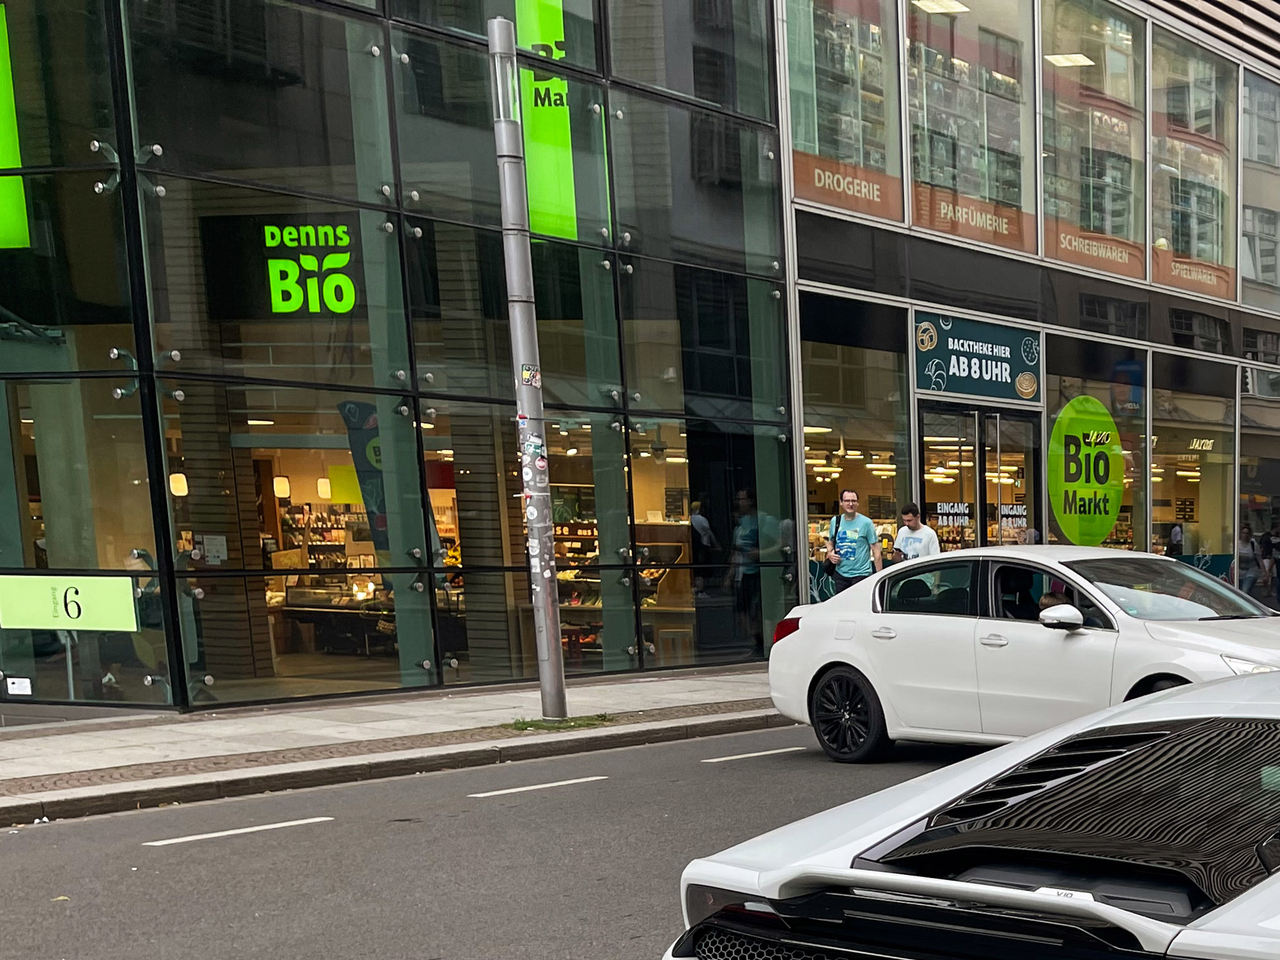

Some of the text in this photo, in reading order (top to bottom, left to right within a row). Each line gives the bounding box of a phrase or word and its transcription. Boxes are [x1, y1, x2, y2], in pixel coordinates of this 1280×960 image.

[534, 87, 568, 107] Ma
[814, 168, 881, 201] DROGERIE
[941, 202, 1008, 234] PARFÜMERIE
[264, 225, 350, 247] Denns
[1060, 233, 1129, 263] SCHREIBWAREN
[268, 254, 355, 313] Bio
[1171, 262, 1217, 285] SPIELWAREN
[948, 337, 1011, 358] BACKTHEKE HIER
[949, 355, 1011, 383] AB 8 UHR
[1064, 433, 1110, 485] Bio
[937, 503, 969, 513] EINGANG
[1063, 489, 1110, 516] Markt
[938, 516, 948, 526] AB
[954, 516, 969, 526] UHR
[64, 586, 82, 619] 6
